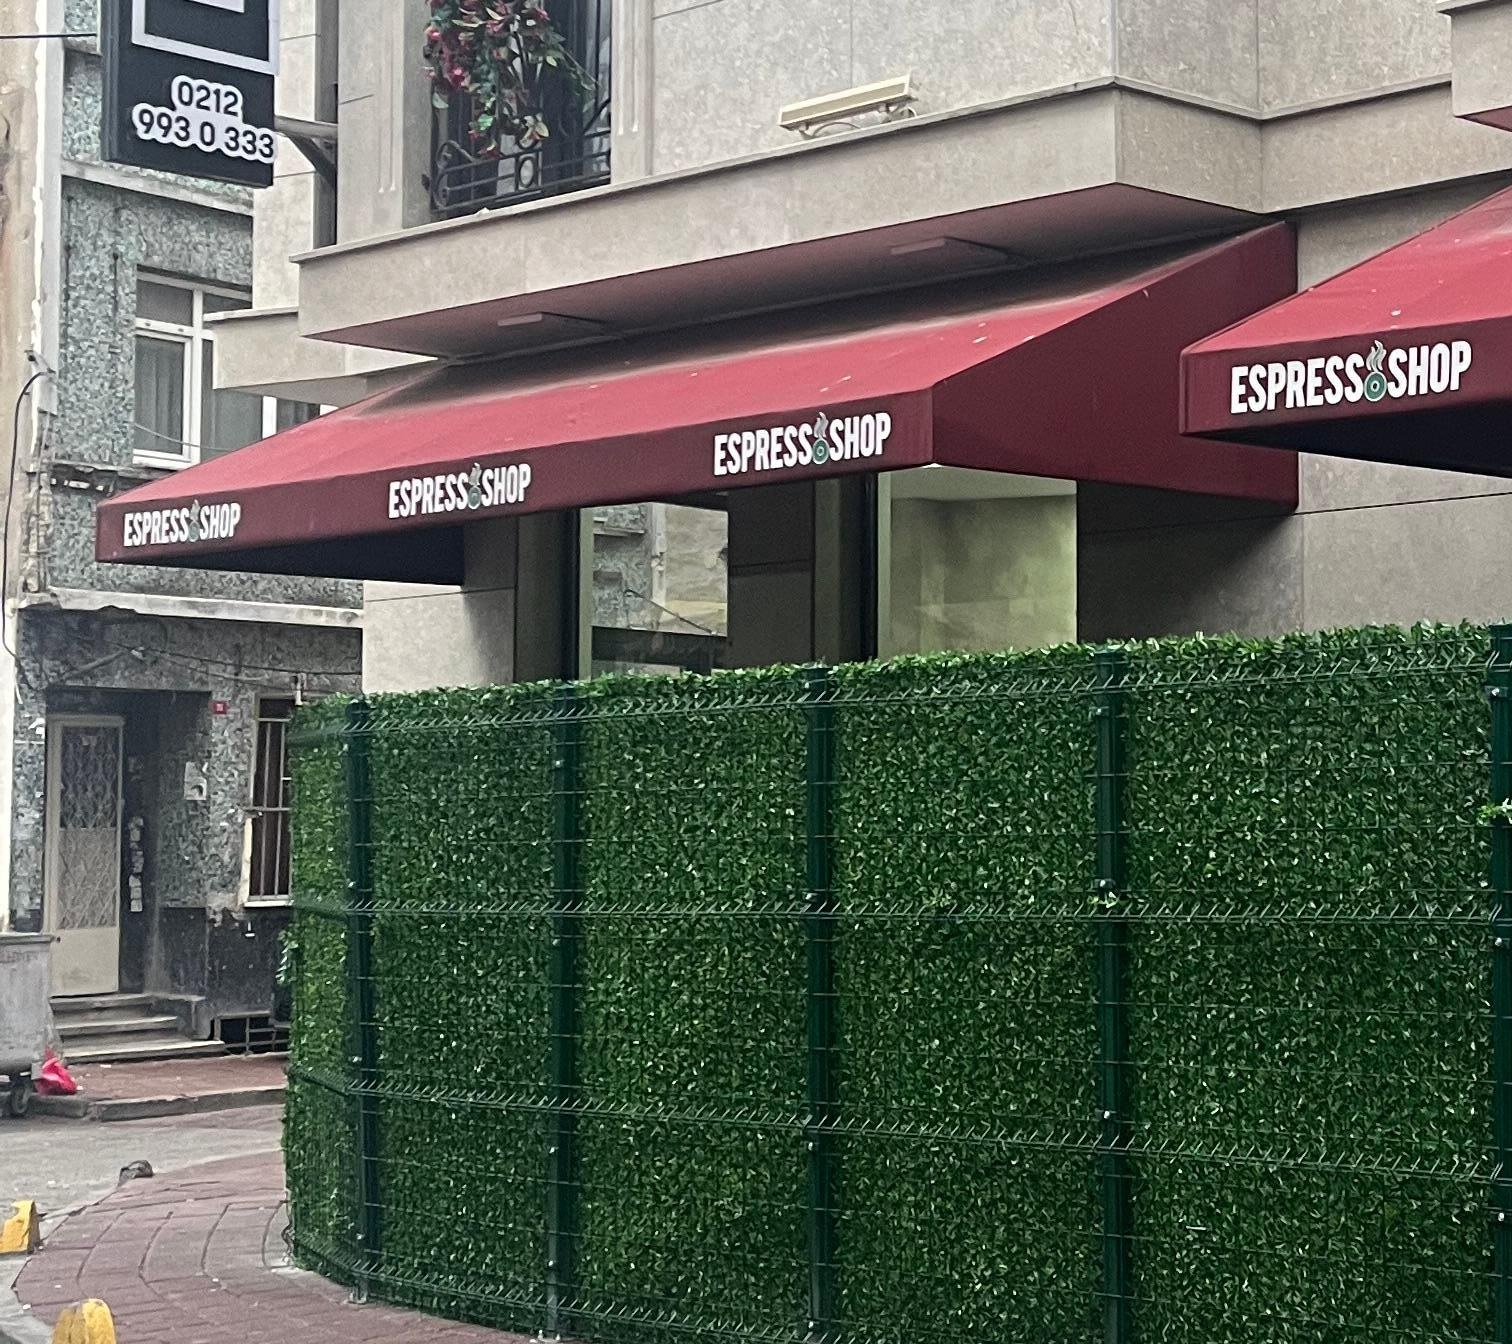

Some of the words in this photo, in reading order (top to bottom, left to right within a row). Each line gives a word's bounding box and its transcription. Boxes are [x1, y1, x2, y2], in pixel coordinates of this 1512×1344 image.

[177, 81, 239, 117] 0212
[138, 109, 190, 142] 993
[200, 121, 215, 147] 0
[224, 126, 274, 158] 333
